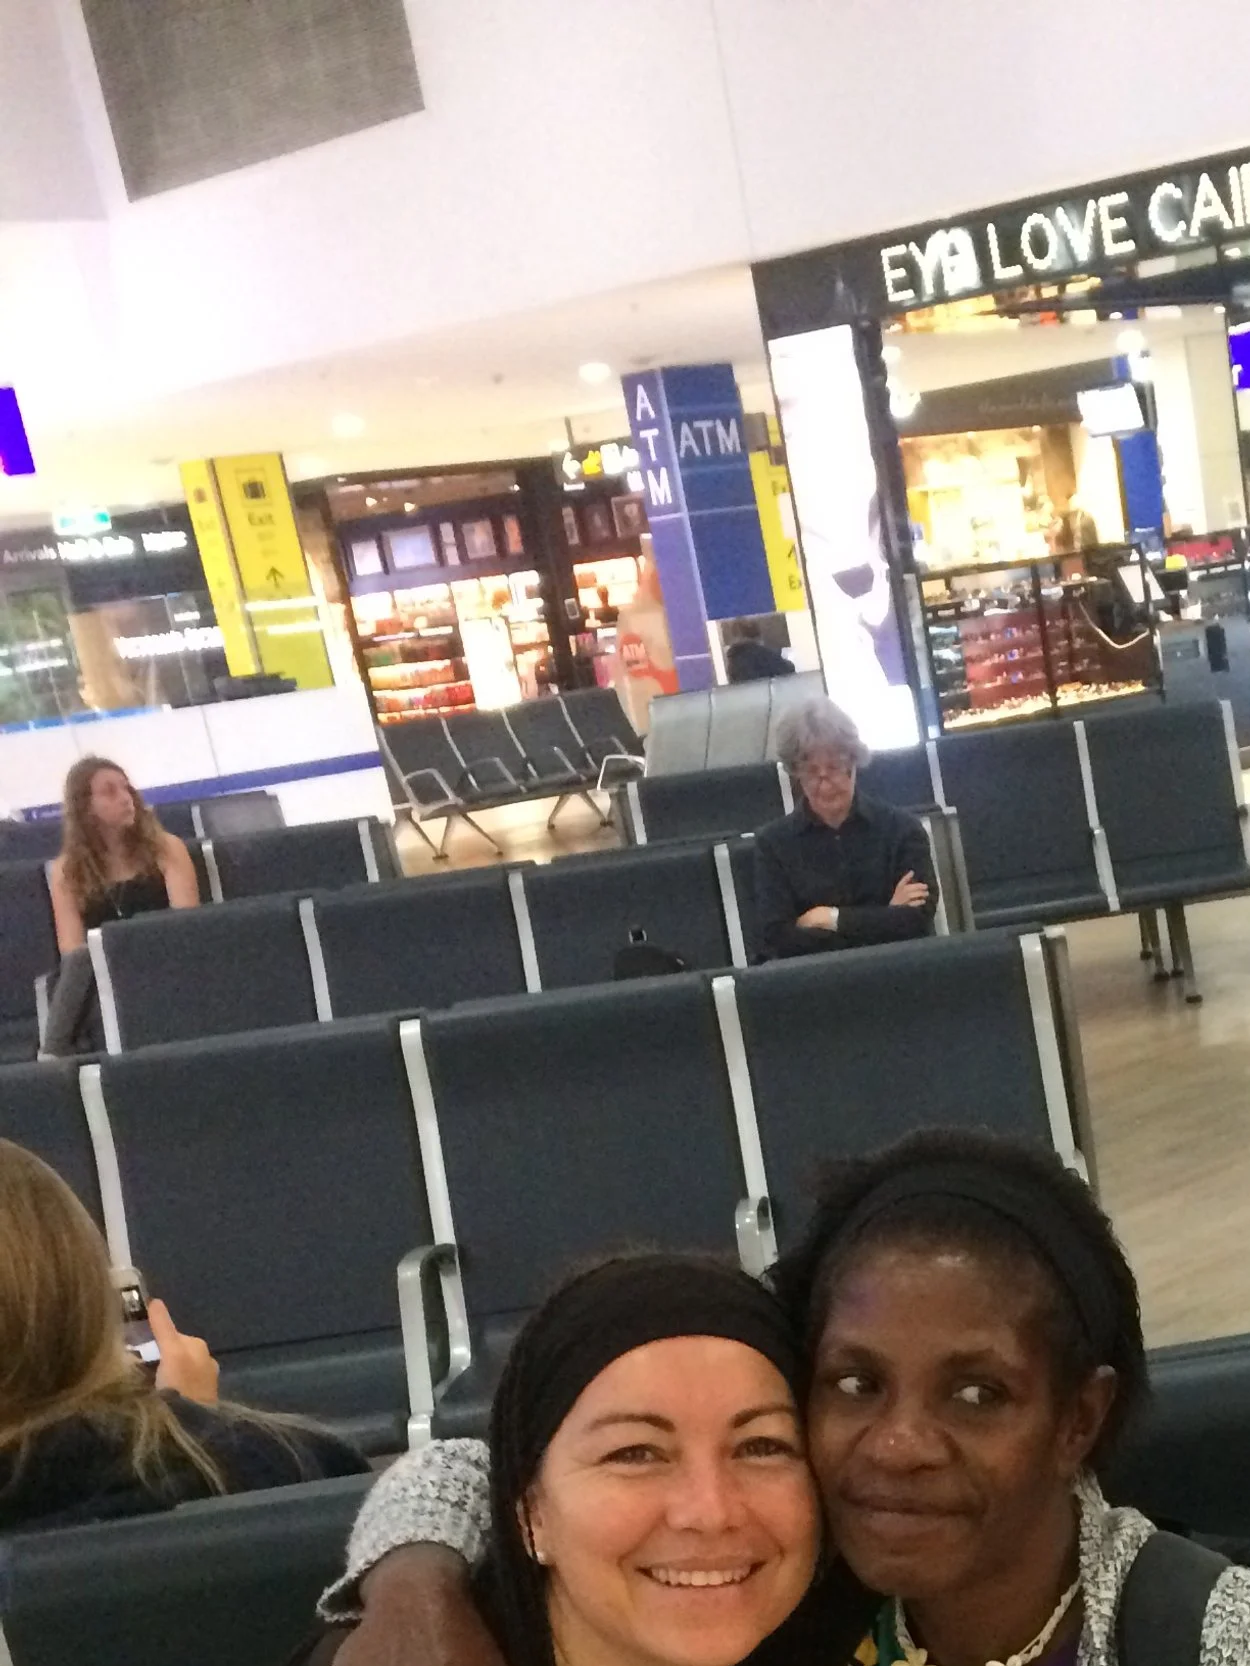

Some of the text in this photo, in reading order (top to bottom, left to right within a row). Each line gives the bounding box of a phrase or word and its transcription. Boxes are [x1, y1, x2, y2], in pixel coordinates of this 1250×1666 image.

[987, 192, 1135, 279] LOVE
[636, 384, 672, 506] ATM
[679, 418, 741, 458] ATM
